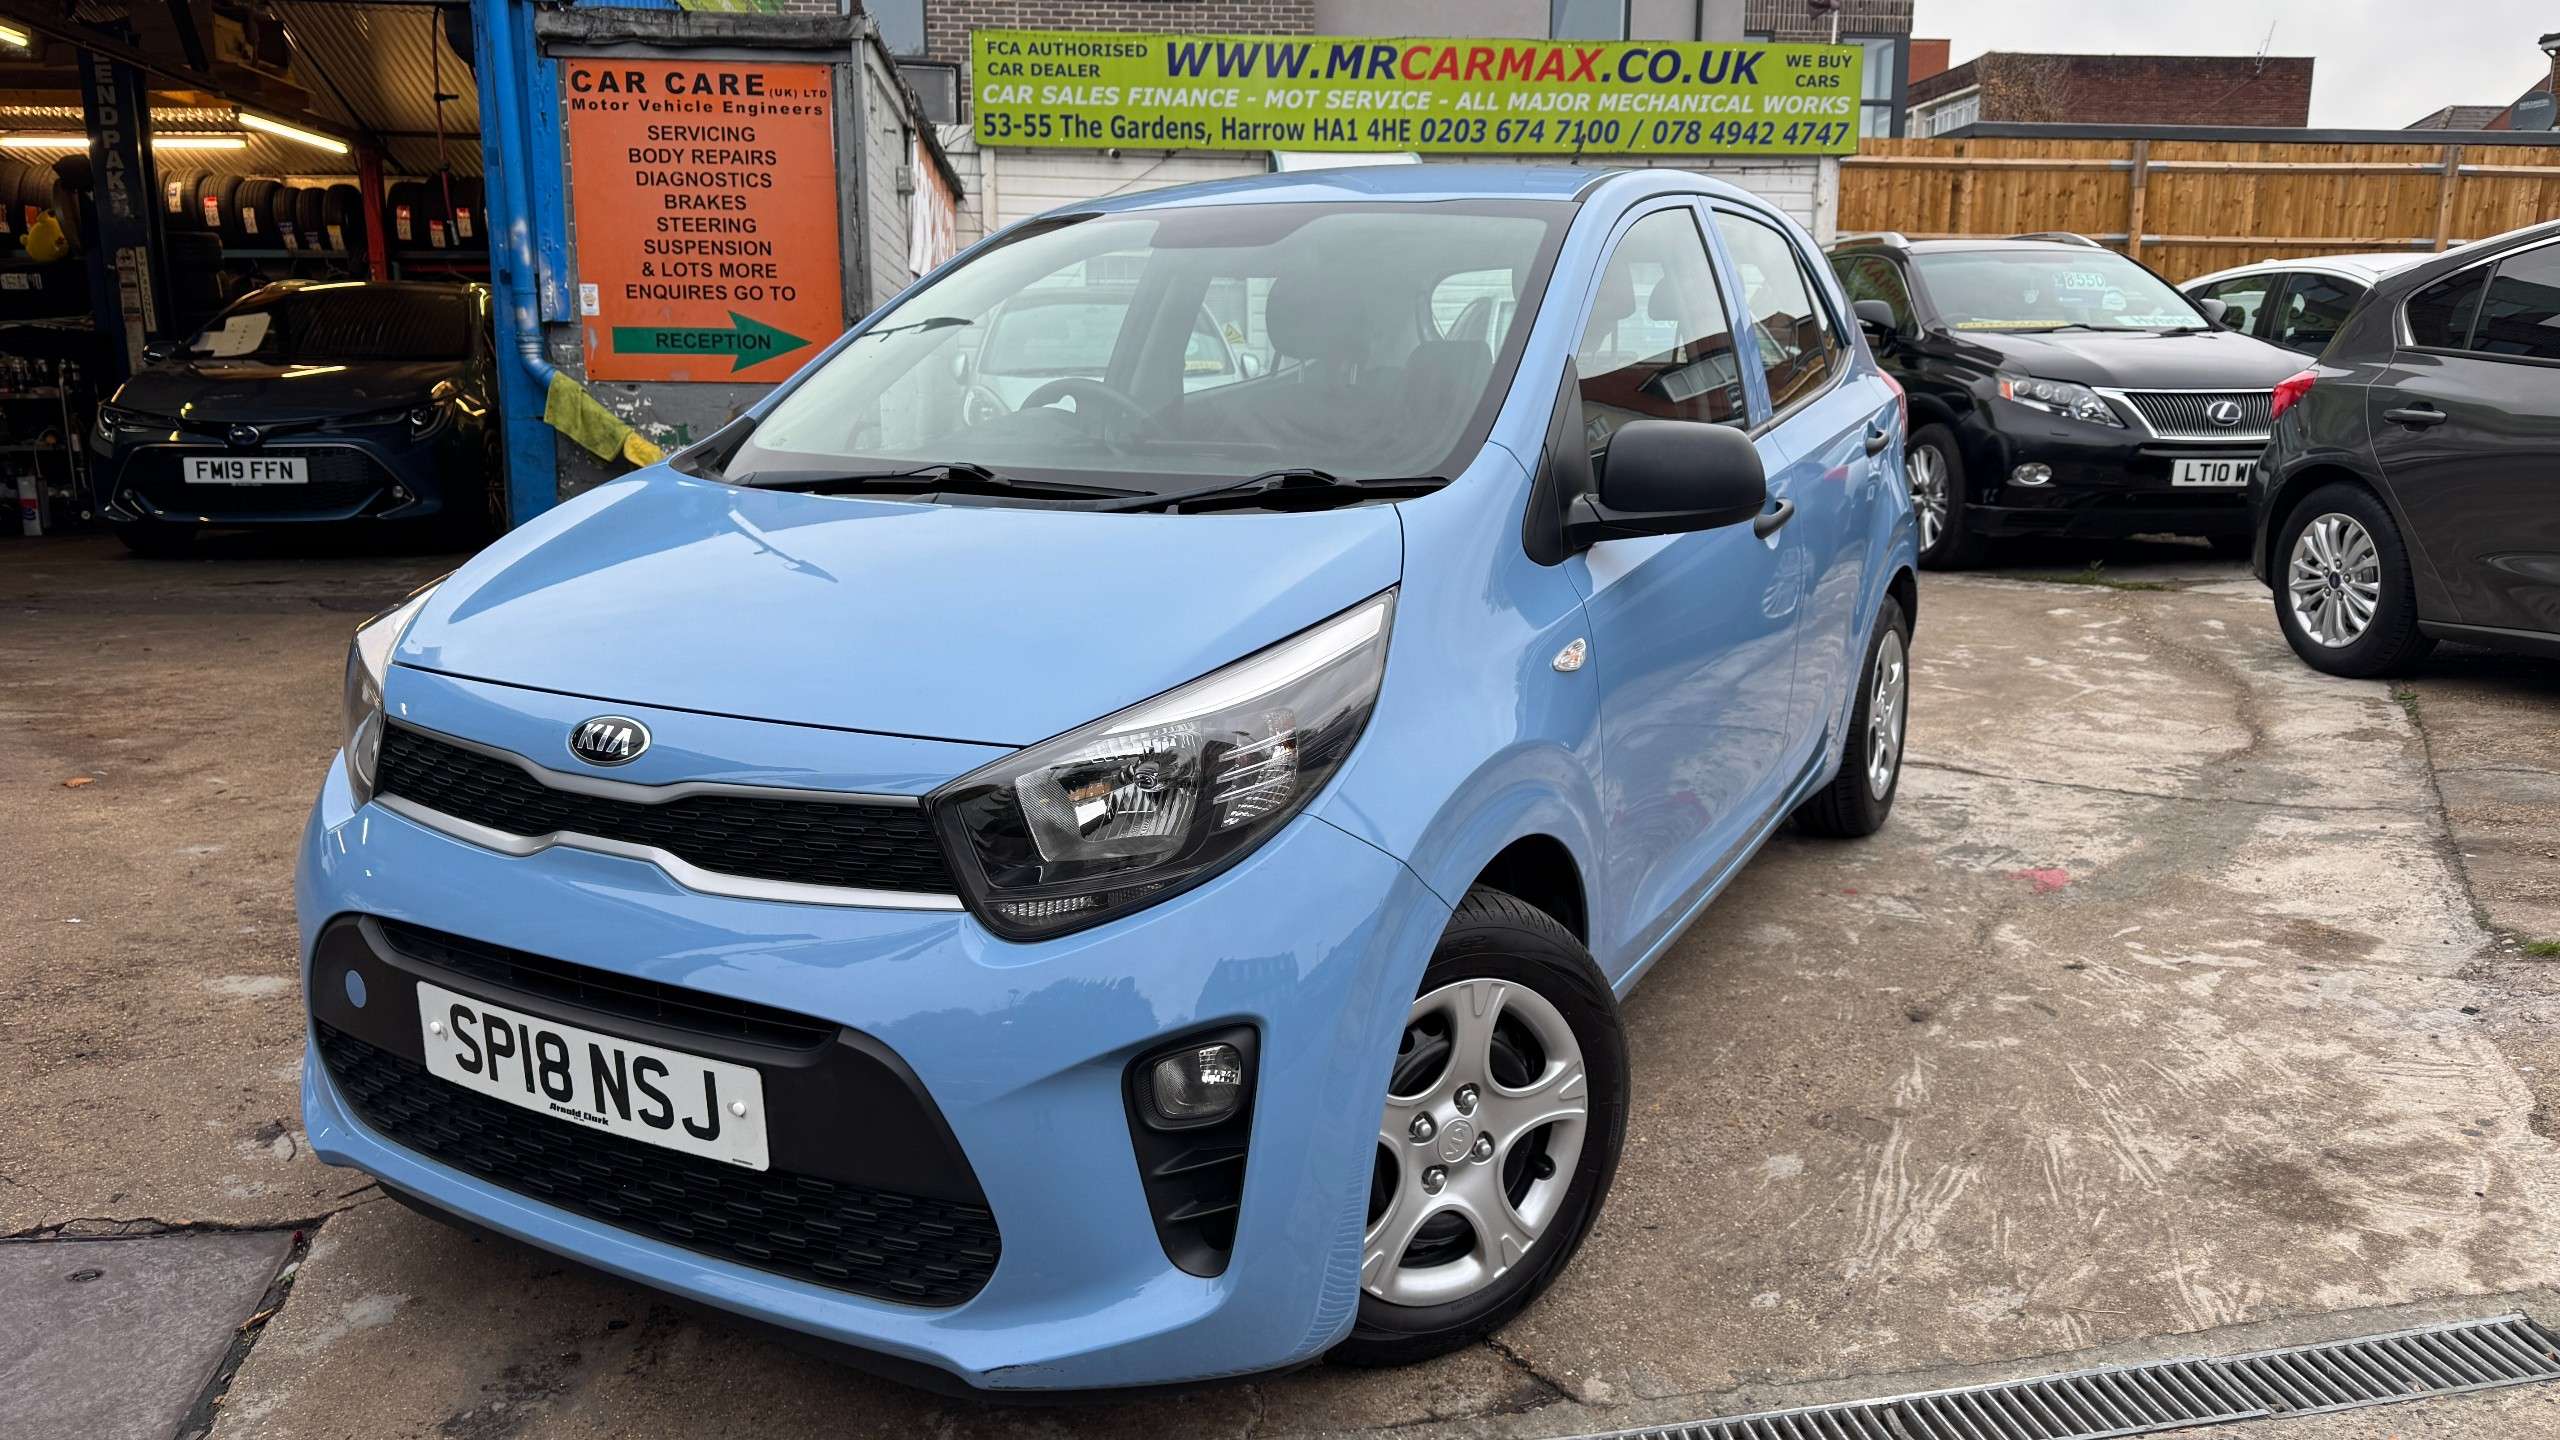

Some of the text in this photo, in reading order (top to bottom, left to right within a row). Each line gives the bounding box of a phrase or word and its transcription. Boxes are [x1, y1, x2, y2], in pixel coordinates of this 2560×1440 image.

[987, 41, 1148, 58] FCA AUTHORISED
[988, 62, 1100, 78] CAR DEALER
[1167, 42, 1765, 84] WWW.MRCARMAX.CO.UK
[1786, 54, 1852, 68] WE BUY
[571, 70, 828, 99] CAR CARE (UK) LTD
[1795, 75, 1840, 88] CARS
[571, 98, 823, 117] Motor Vehicle Engineers
[983, 84, 1033, 105] CAR
[1041, 86, 1120, 107] SALES
[1129, 87, 1240, 108] FINANCE
[1265, 89, 1319, 109] MOT
[1326, 90, 1430, 111] SERVICE
[1456, 92, 1498, 110] ALL
[1509, 92, 1590, 112] MAJOR
[1597, 93, 1754, 113] MECHANICAL
[1764, 95, 1850, 114] WORKS
[93, 53, 126, 192] ENDPAK
[983, 113, 1052, 138] 53-55
[1060, 114, 1102, 138] The
[1111, 114, 1212, 145] Gardens,
[1222, 117, 1305, 141] Harrow
[1314, 118, 1358, 141] HA1
[1368, 119, 1411, 142] 4HE
[1420, 118, 1486, 143] 0203
[1496, 118, 1545, 143] 674
[1557, 119, 1620, 144] 7100
[1652, 120, 1702, 144] 078
[1710, 120, 1775, 145] 4942
[1783, 121, 1849, 145] 4747
[648, 125, 756, 142] SERVICING
[629, 148, 777, 166] BODY REPAIRS
[636, 171, 773, 188] DIAGNOSTICS
[664, 194, 747, 210] BRAKES
[657, 217, 757, 233] STEERING
[644, 239, 772, 256] SUSPENSION
[642, 262, 777, 279] & LOTS MORE
[626, 284, 796, 301] ENQUIRES GO TO
[656, 332, 772, 350] RECEPTION
[196, 461, 294, 480] FM19 FFN
[2184, 463, 2230, 482] LT10
[577, 723, 632, 756] KIA
[450, 1003, 720, 1141] SP18 NSJ
